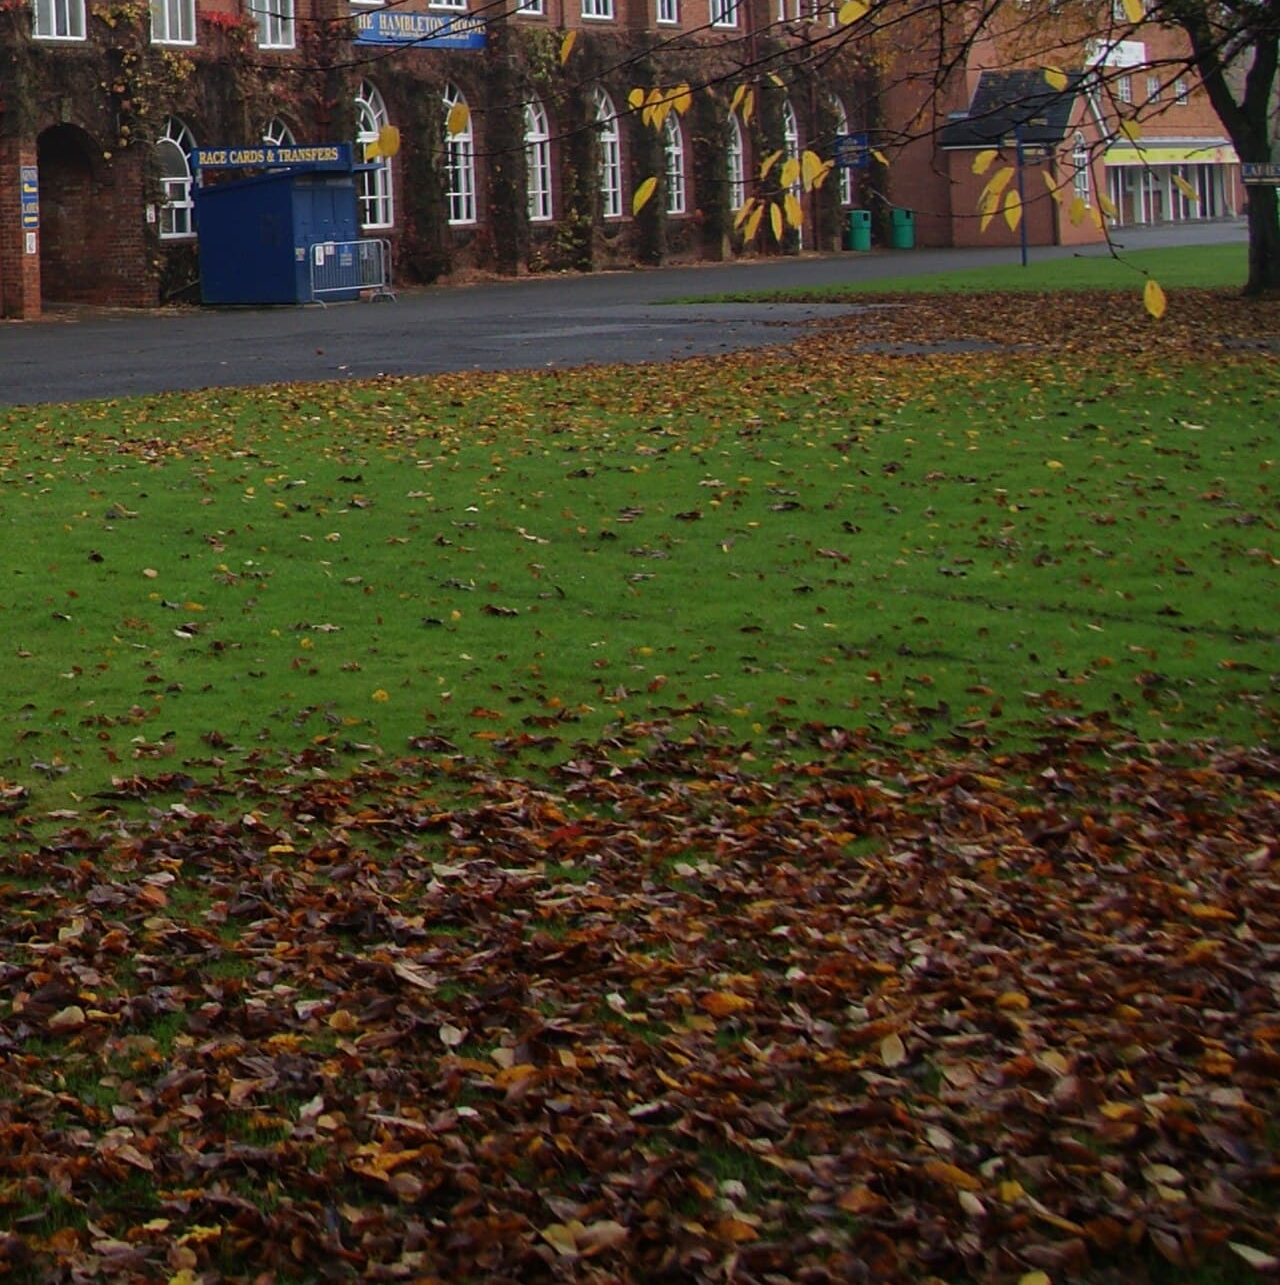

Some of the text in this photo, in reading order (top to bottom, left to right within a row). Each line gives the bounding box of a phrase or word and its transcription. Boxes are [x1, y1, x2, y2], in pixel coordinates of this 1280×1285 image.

[199, 148, 338, 164] RACE CARDS & TRANSFERS
